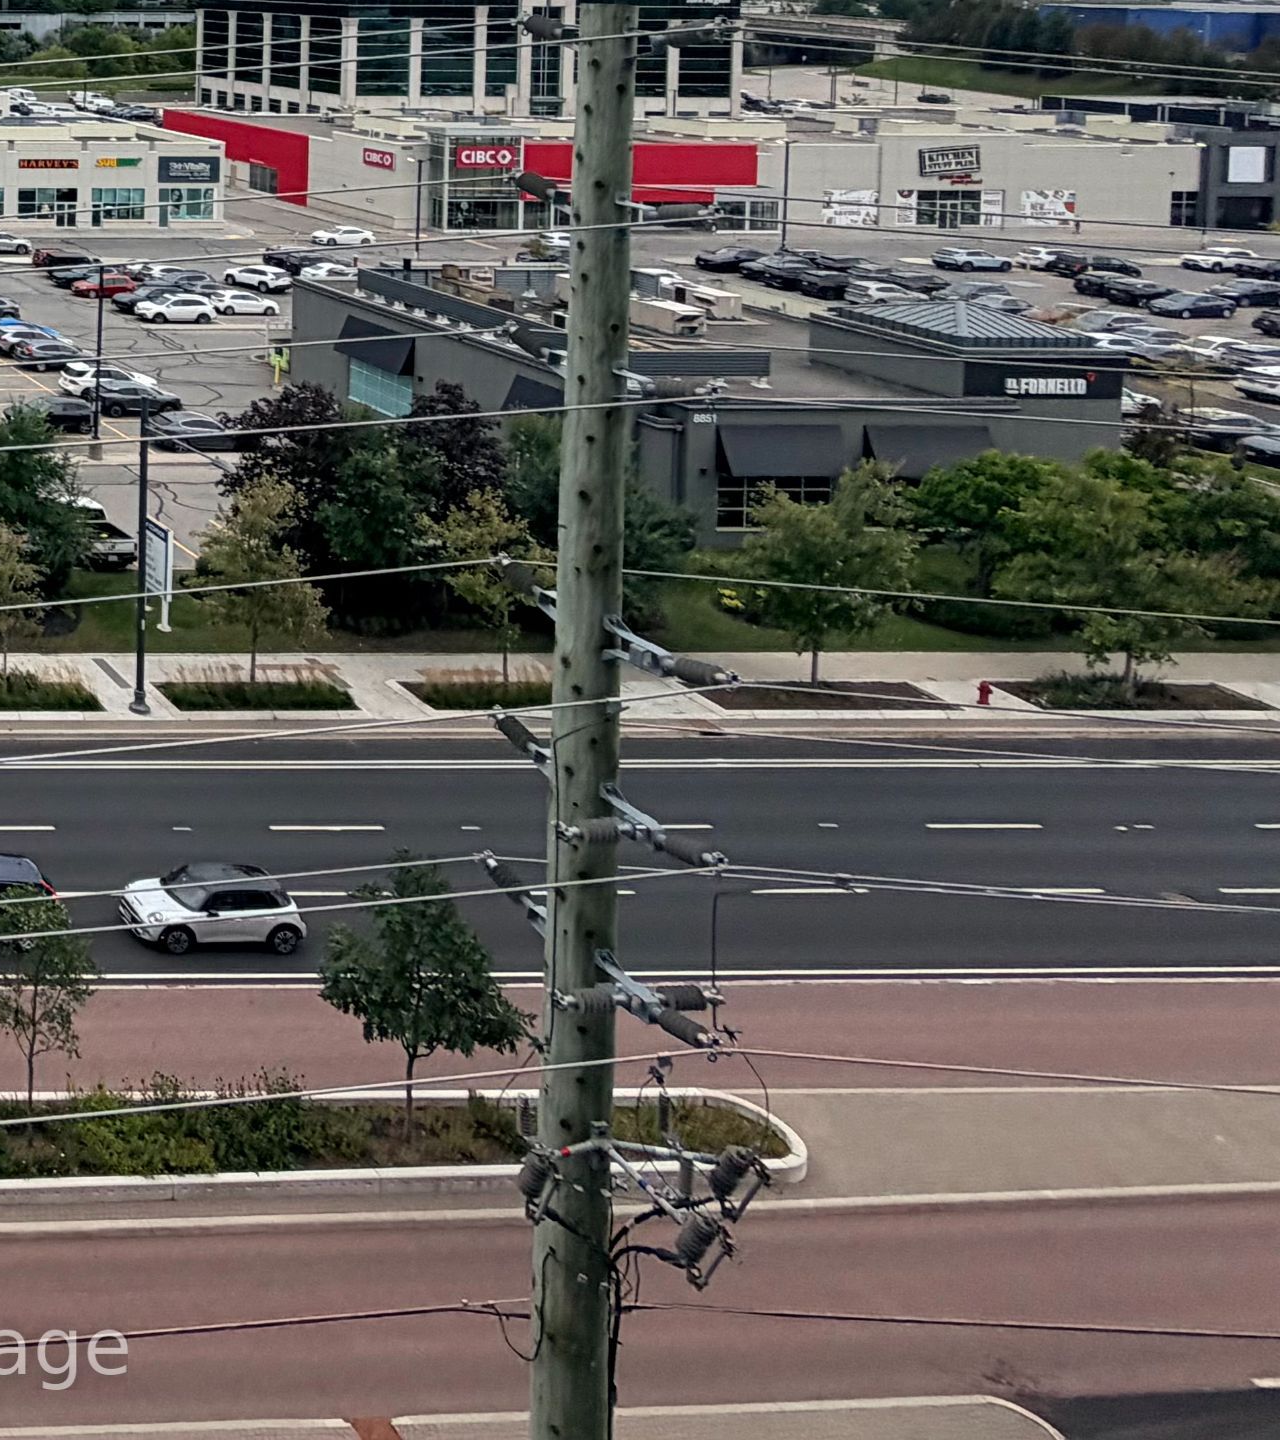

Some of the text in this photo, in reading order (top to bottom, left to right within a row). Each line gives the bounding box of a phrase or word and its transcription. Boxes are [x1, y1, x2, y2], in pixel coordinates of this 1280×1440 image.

[364, 152, 384, 164] CIBC
[461, 150, 496, 164] CIBC
[927, 151, 974, 162] KITCHEN
[19, 159, 79, 168] HARVEY'S
[927, 160, 975, 170] STUFF PLUS
[1020, 378, 1087, 394] FORNELLO
